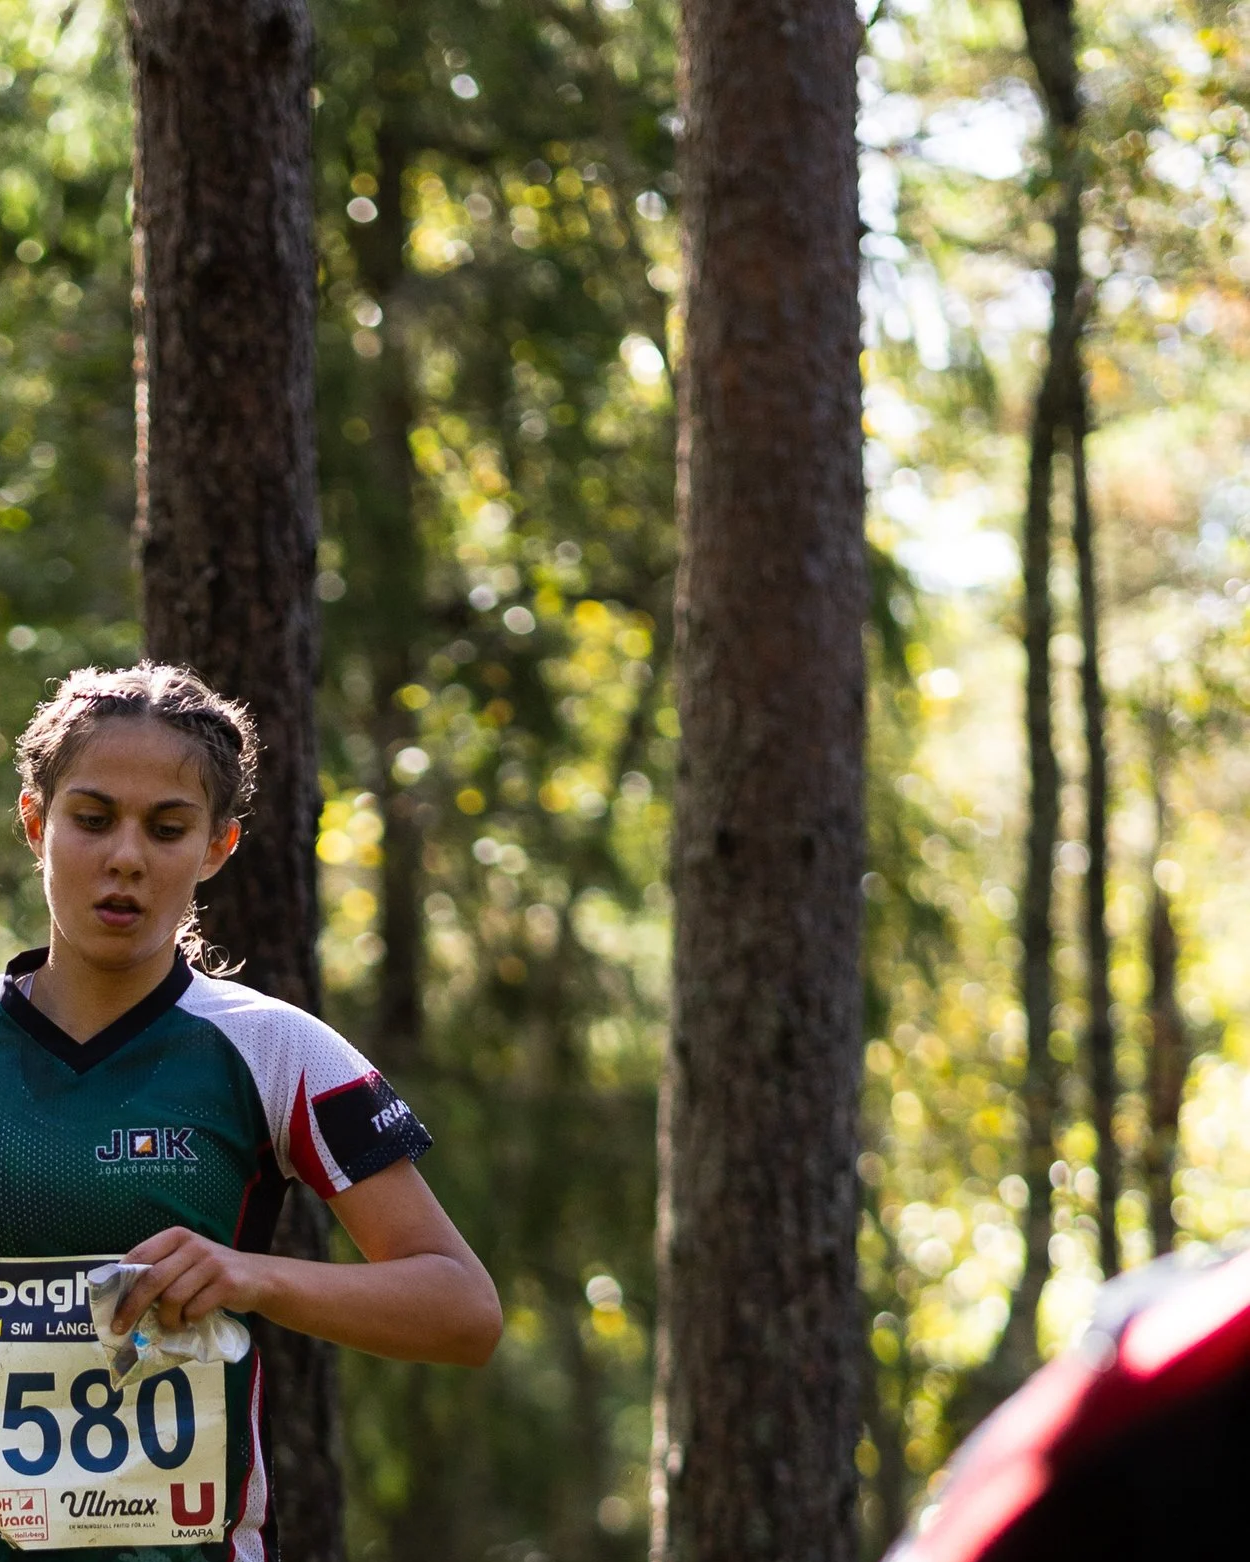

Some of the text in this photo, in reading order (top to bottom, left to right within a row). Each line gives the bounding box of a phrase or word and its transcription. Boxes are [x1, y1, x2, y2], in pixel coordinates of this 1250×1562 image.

[95, 1127, 199, 1162] JOK
[10, 1322, 33, 1336] SM
[1, 1366, 196, 1476] 580
[60, 1489, 157, 1518] Ullmax
[171, 1528, 214, 1539] UMARA
